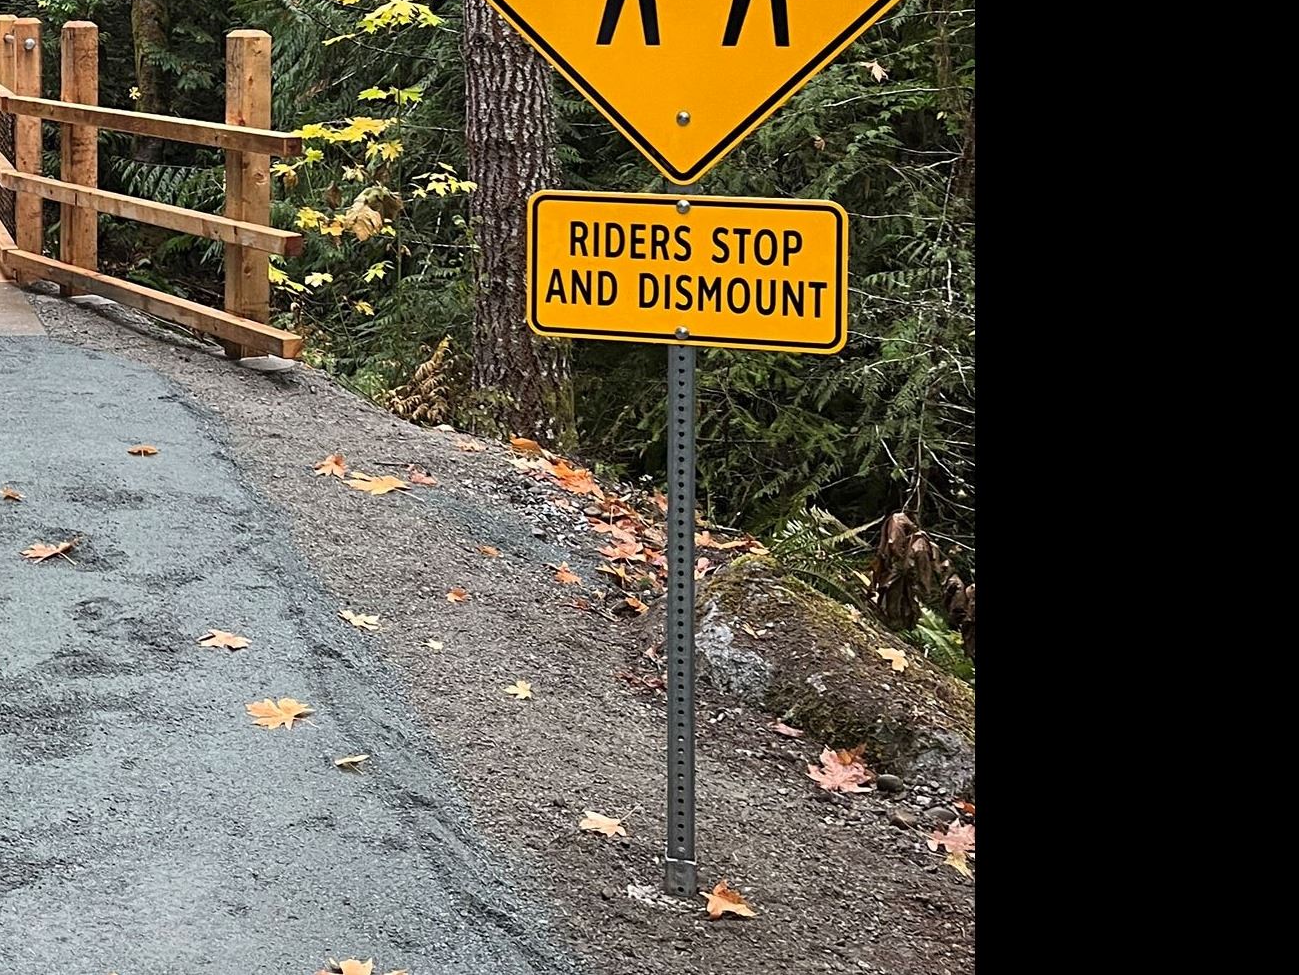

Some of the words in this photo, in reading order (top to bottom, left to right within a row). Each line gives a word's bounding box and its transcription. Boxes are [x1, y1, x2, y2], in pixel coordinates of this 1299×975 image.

[569, 221, 691, 261] RIDERS
[711, 227, 803, 267] STOP
[545, 268, 618, 306] AND
[638, 272, 828, 318] DISMOUNT
